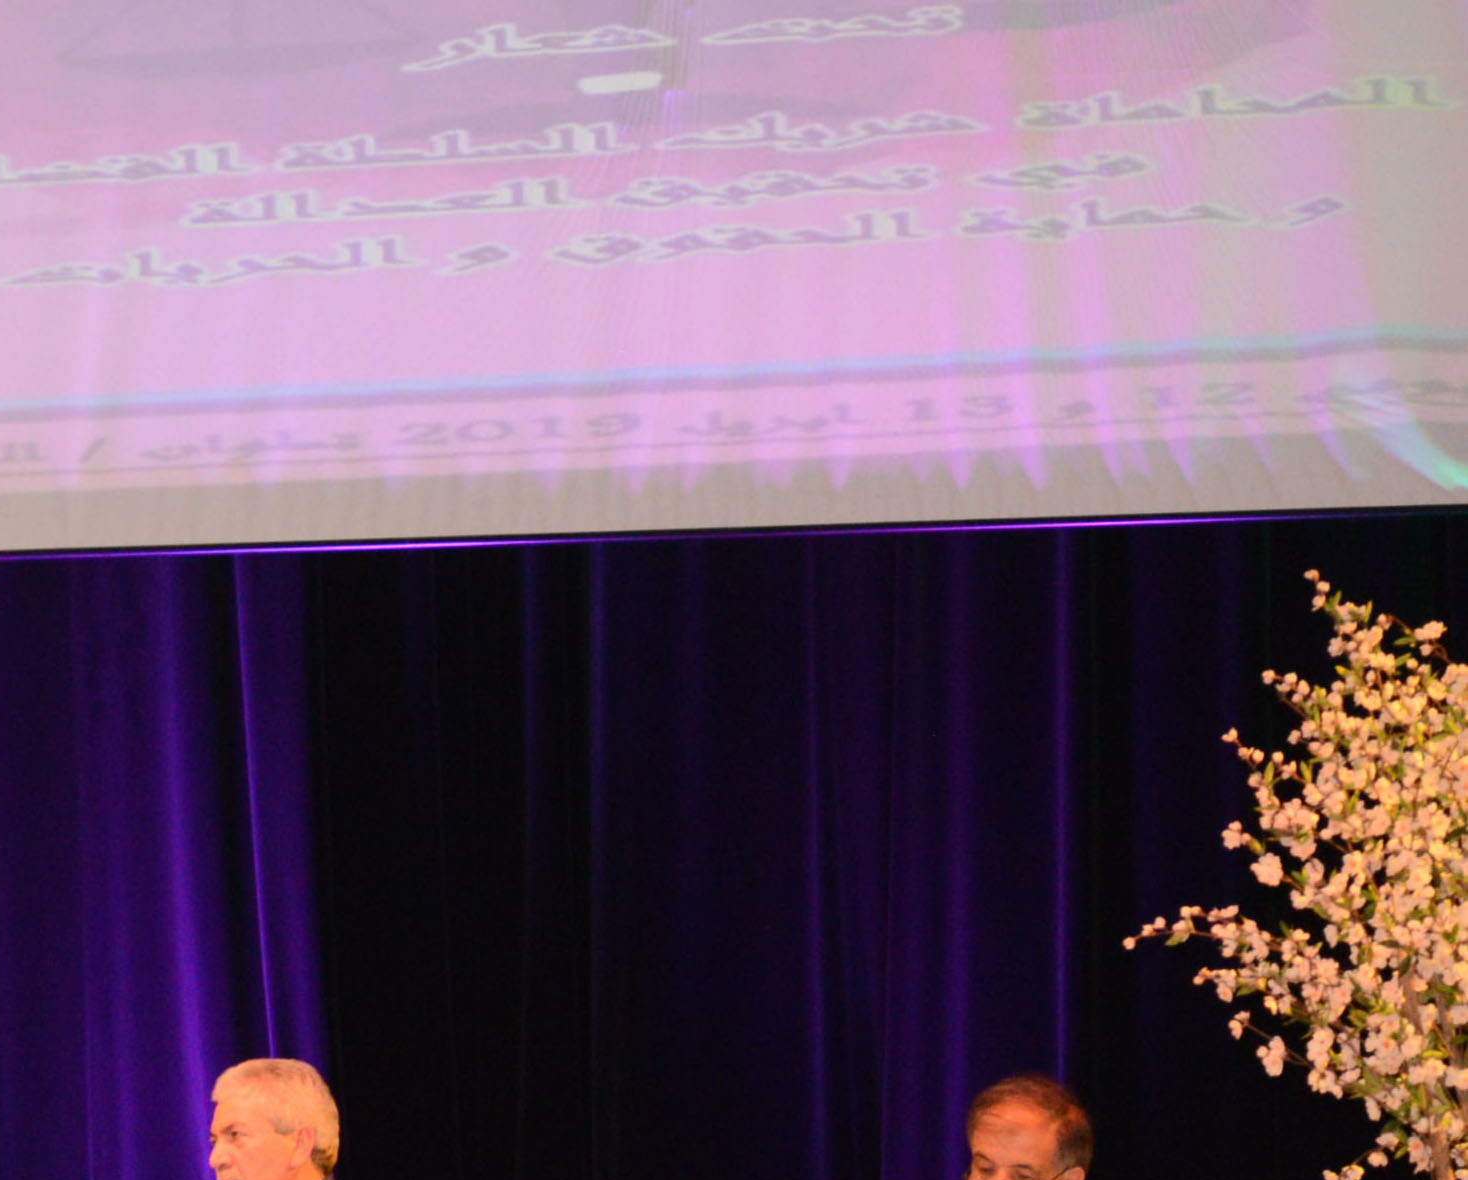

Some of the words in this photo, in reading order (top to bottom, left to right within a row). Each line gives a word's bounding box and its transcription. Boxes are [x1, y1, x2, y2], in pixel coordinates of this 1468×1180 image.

[400, 23, 676, 72] شعار
[1014, 74, 1456, 128] المحاماة
[272, 122, 638, 173] السلطة
[611, 166, 936, 209] تحقيق
[971, 152, 1154, 190] في
[180, 176, 594, 227] العدالة
[961, 198, 1260, 241] حماية
[1267, 194, 1350, 231] و
[545, 209, 939, 266] الحقوق
[434, 242, 517, 277] و
[392, 411, 643, 446] 2019
[905, 394, 1012, 421] 13
